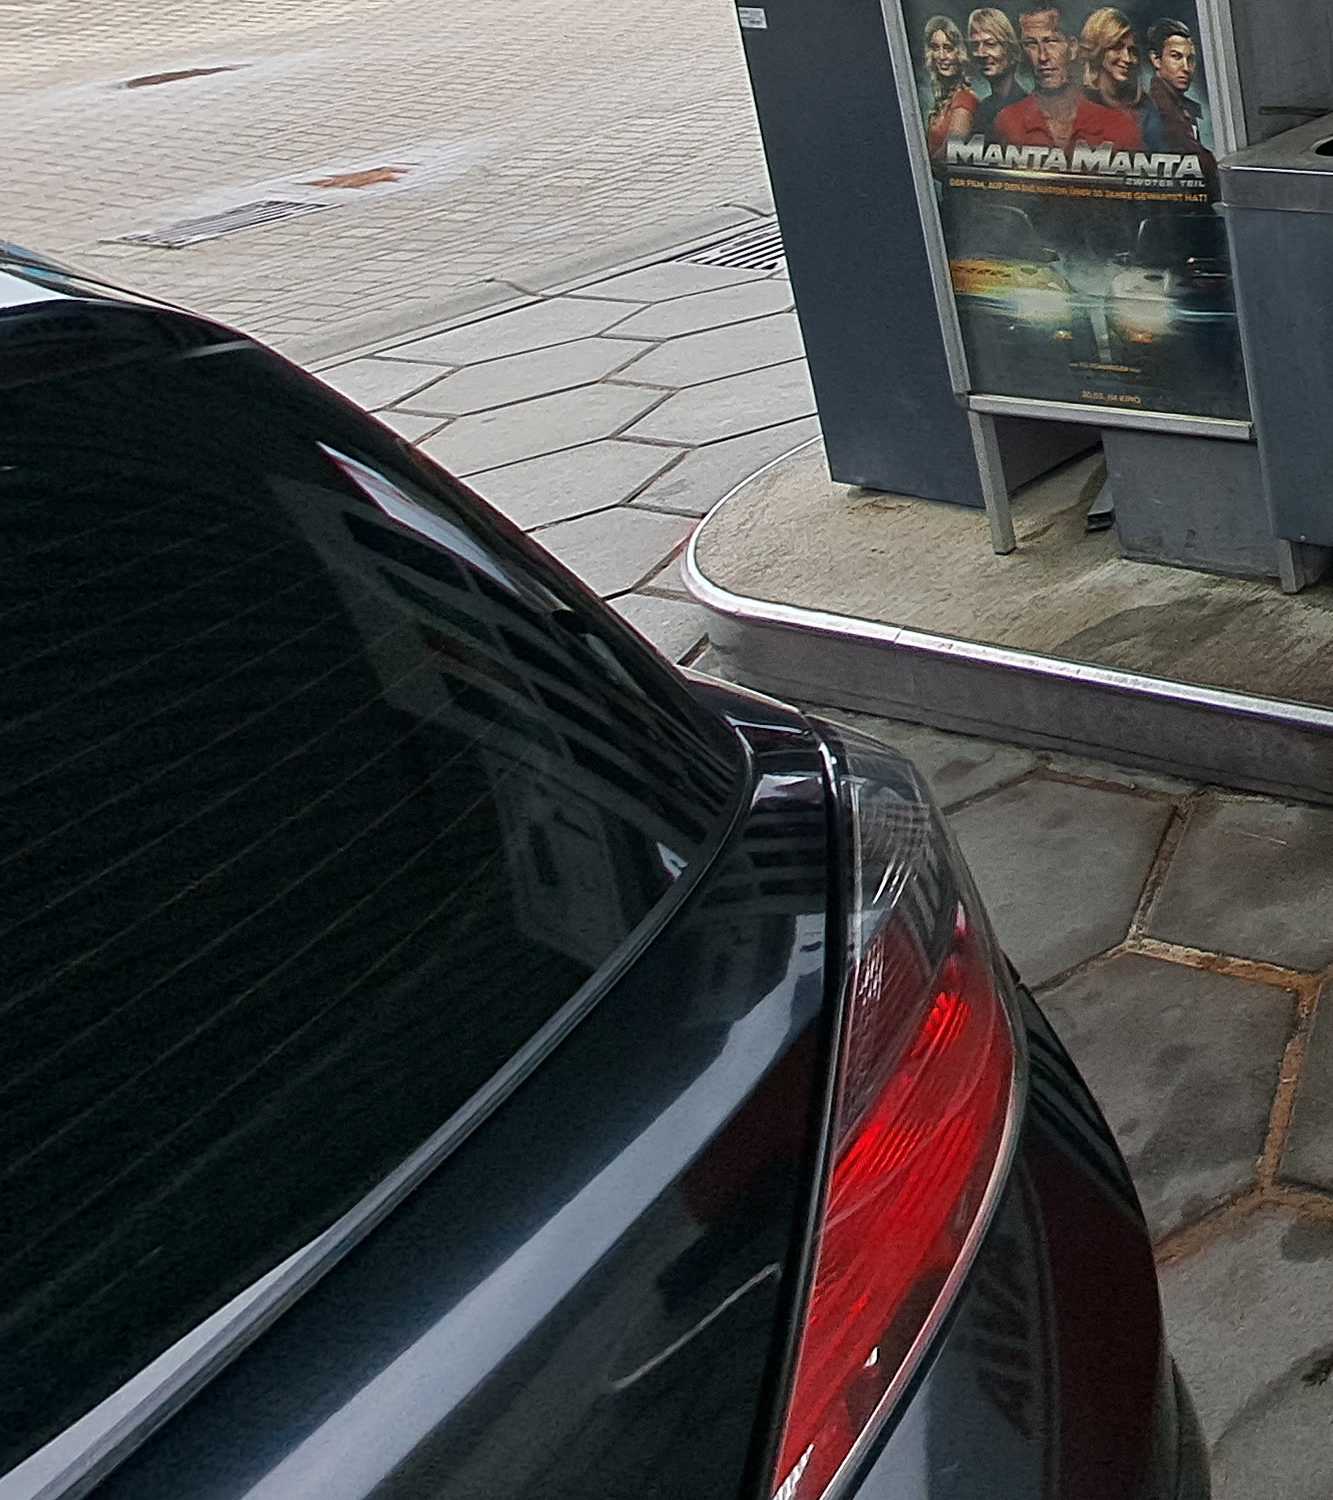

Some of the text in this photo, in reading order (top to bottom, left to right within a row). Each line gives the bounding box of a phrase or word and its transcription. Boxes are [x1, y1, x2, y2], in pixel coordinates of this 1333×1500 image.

[946, 133, 1205, 178] MANTA MANTA
[1179, 180, 1206, 188] TEIL
